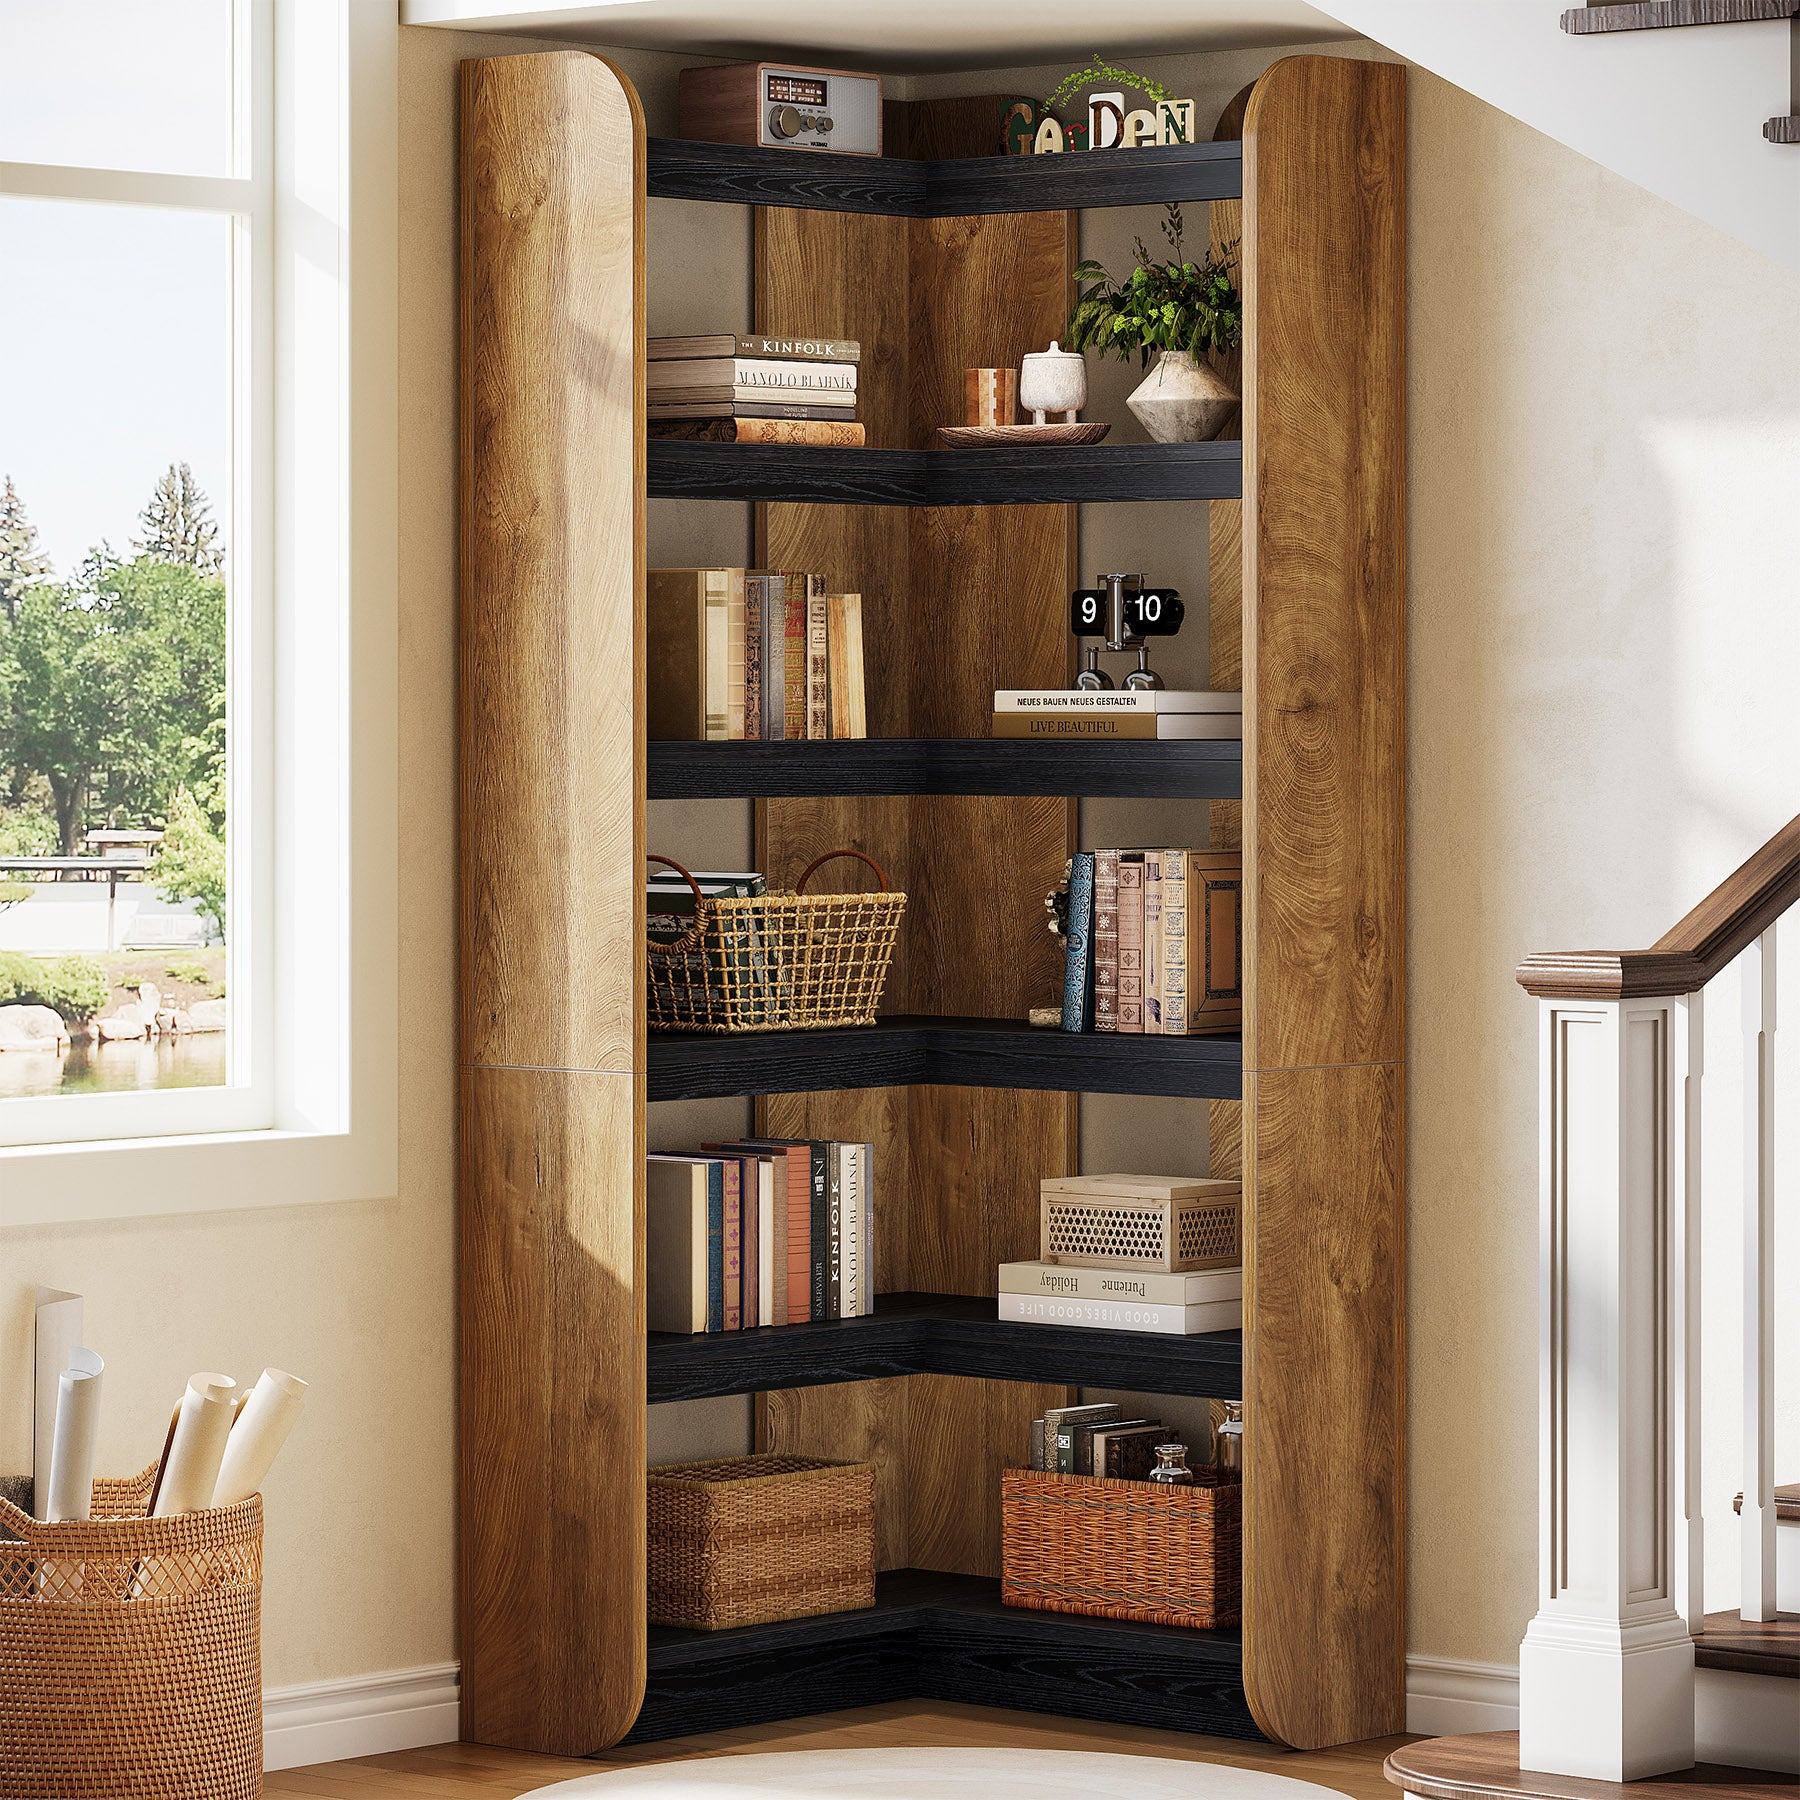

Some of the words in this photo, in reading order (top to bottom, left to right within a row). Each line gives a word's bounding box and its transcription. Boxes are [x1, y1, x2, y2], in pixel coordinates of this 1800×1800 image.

[763, 340, 835, 356] KINFOLK
[738, 371, 797, 388] MANOLO
[801, 373, 854, 389] BLAHNÍK
[1081, 597, 1097, 623] 9
[1134, 595, 1161, 621] 10
[1017, 697, 1041, 706] NEUES
[1043, 697, 1068, 706] BAUEN
[1070, 697, 1094, 706] NEUES
[1096, 697, 1137, 706] GESTALTEN
[1030, 721, 1055, 733] LIVE
[1057, 721, 1118, 733] BEAUTIFUL
[831, 1180, 839, 1282] KINFOLK
[1040, 1272, 1078, 1292] Holiday
[1102, 1280, 1145, 1296] Purienne
[1019, 1302, 1044, 1315] LIFE
[1049, 1304, 1083, 1318] GOOD
[1125, 1311, 1159, 1324] GOOD
